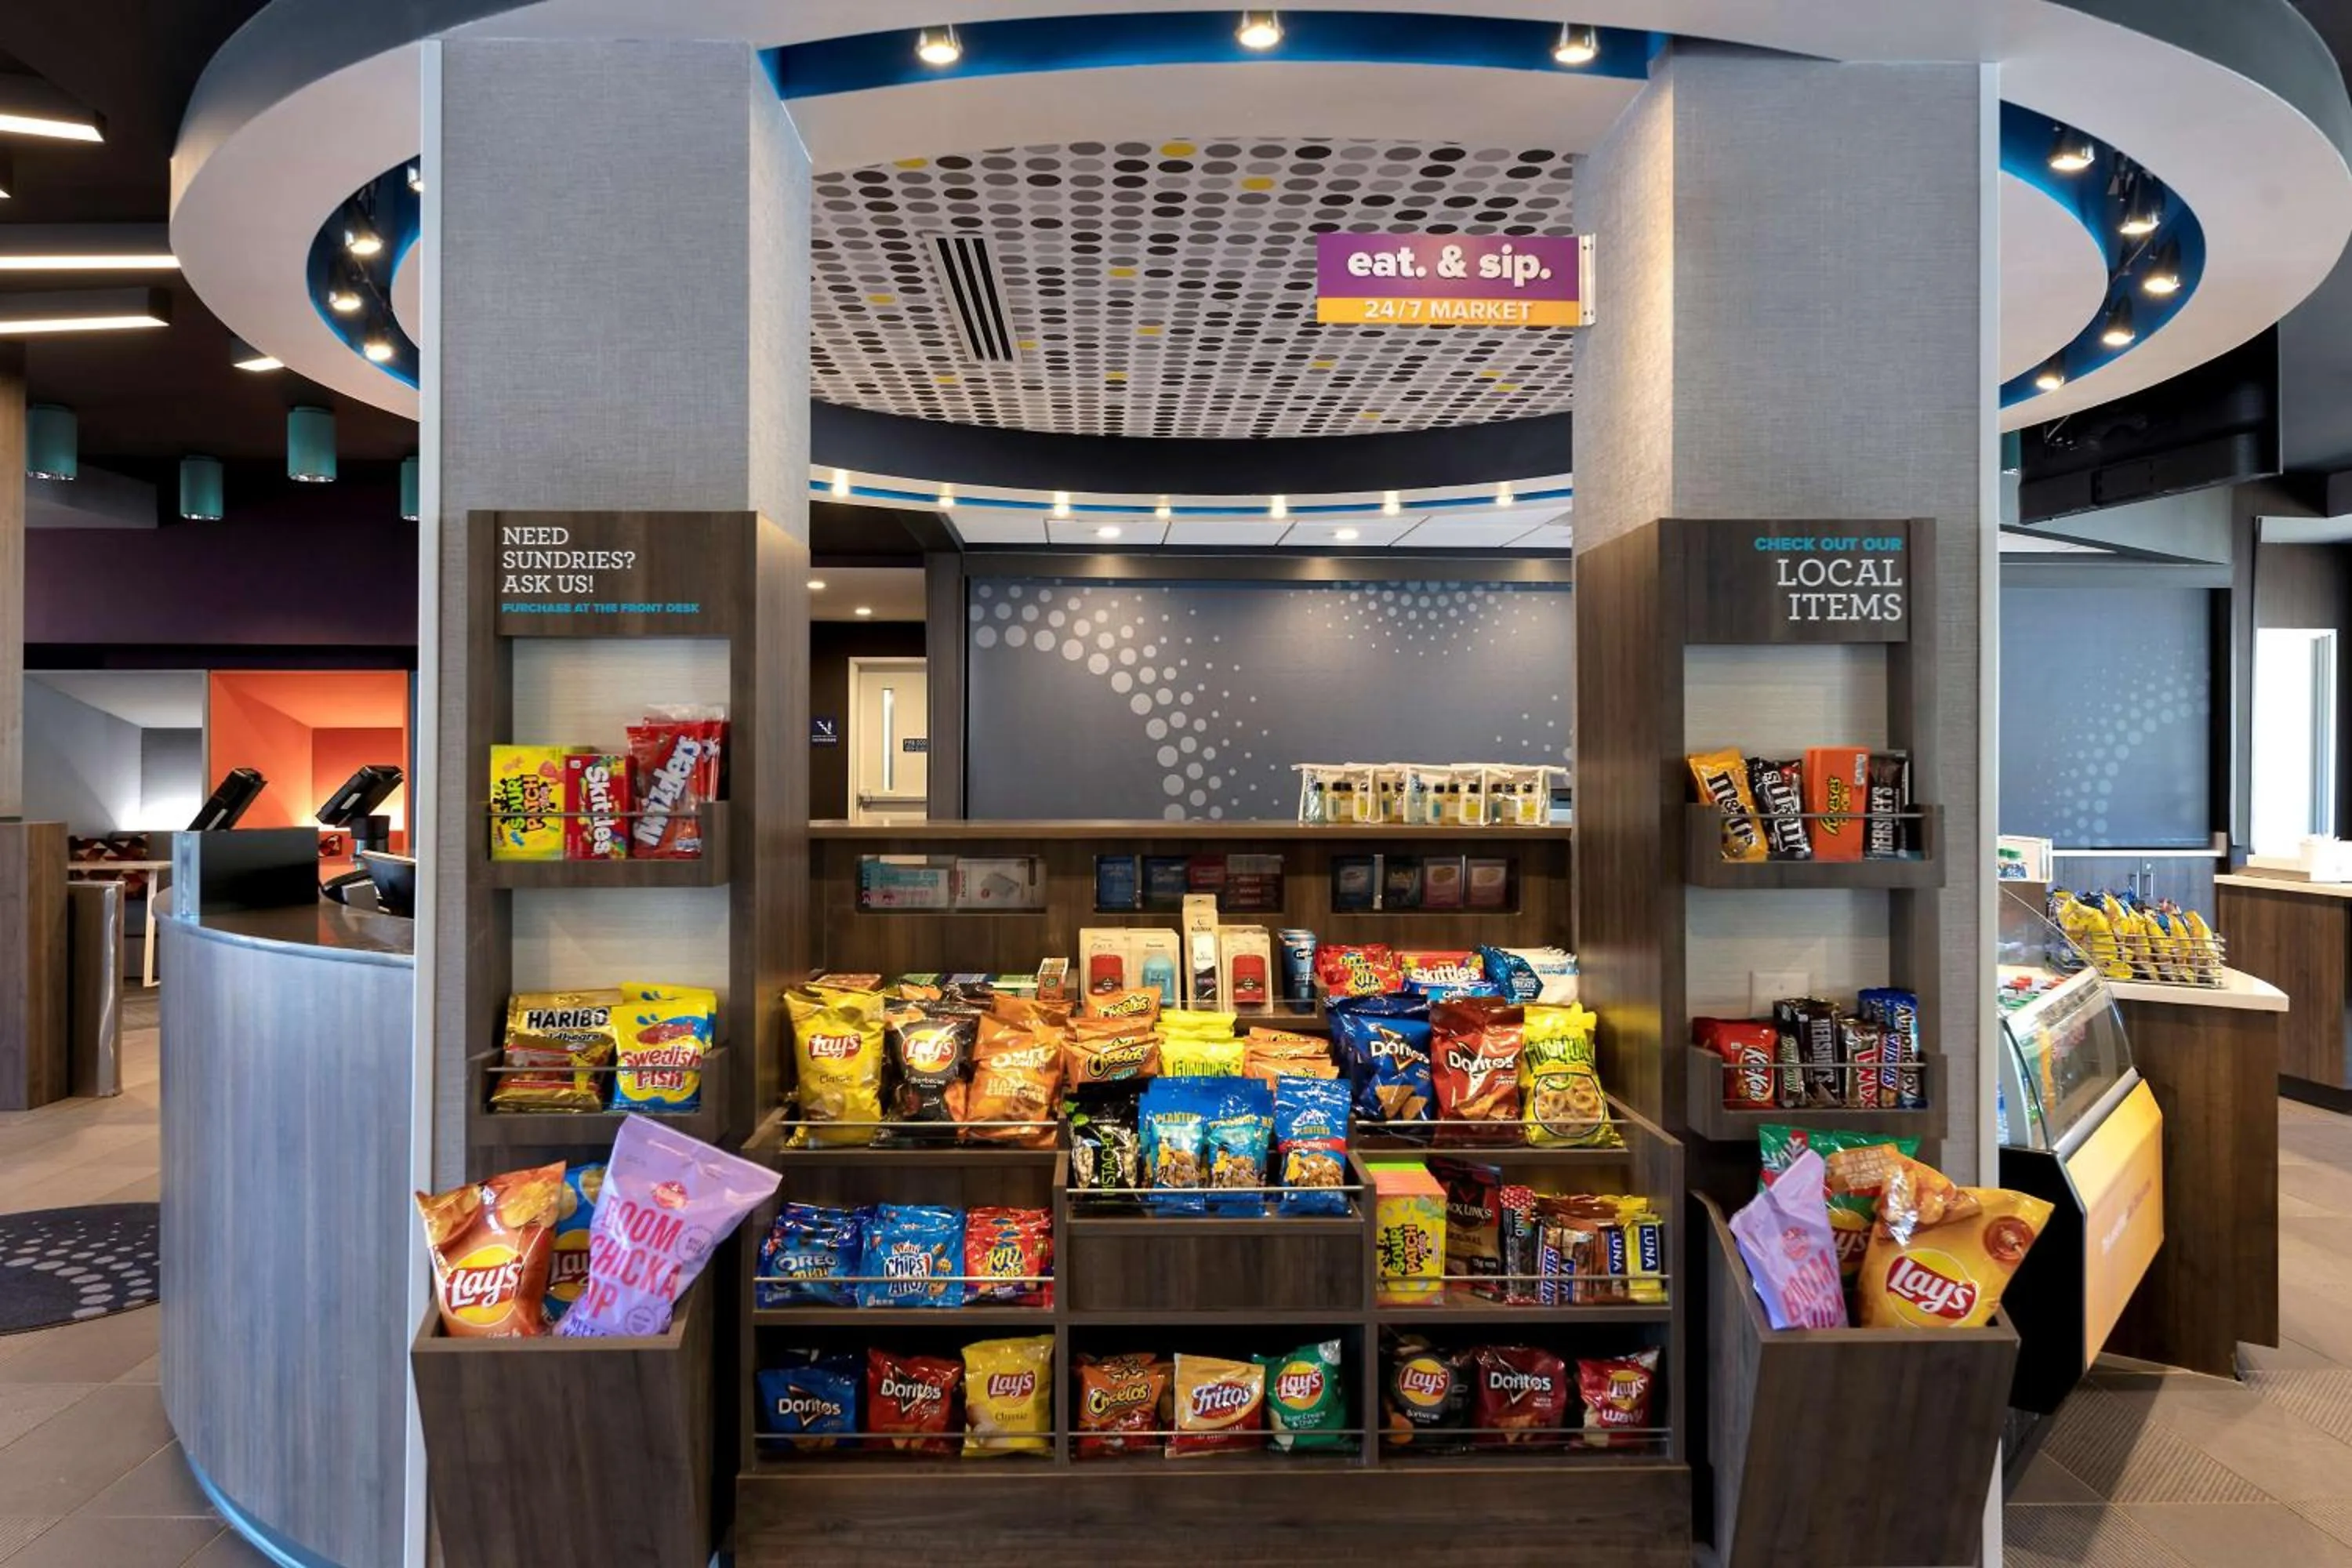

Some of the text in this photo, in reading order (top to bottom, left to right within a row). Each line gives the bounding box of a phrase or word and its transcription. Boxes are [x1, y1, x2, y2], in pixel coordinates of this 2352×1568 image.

[1348, 244, 1552, 288] eat. & sip.
[1364, 300, 1534, 321] 24/7 MARKET
[503, 526, 569, 545] NEED
[1754, 537, 1903, 551] CHECK OUT OUR
[503, 550, 636, 570] SUNDRIES?
[1777, 558, 1903, 587] LOCAL
[503, 574, 594, 593] ASK US!
[502, 602, 700, 614] PURCHASE AT THE FRONT DESK
[1788, 593, 1902, 621] ITEMS
[1410, 965, 1481, 982] Skittles
[528, 1008, 608, 1029] HARIBO
[810, 1033, 861, 1059] Lay's
[1611, 1231, 1622, 1272] LUNA
[1642, 1227, 1657, 1269] LUNA
[777, 1254, 838, 1271] OREO
[451, 1261, 523, 1308] Lay's
[1889, 1258, 1975, 1313] Lay's
[880, 1378, 942, 1402] Doritos
[989, 1370, 1033, 1398] Lay's
[1280, 1370, 1322, 1399] Lay's
[1403, 1367, 1446, 1395] Lay's
[1490, 1371, 1552, 1392] Doritos
[778, 1397, 841, 1416] Doritos
[1192, 1382, 1251, 1416] Fritos
